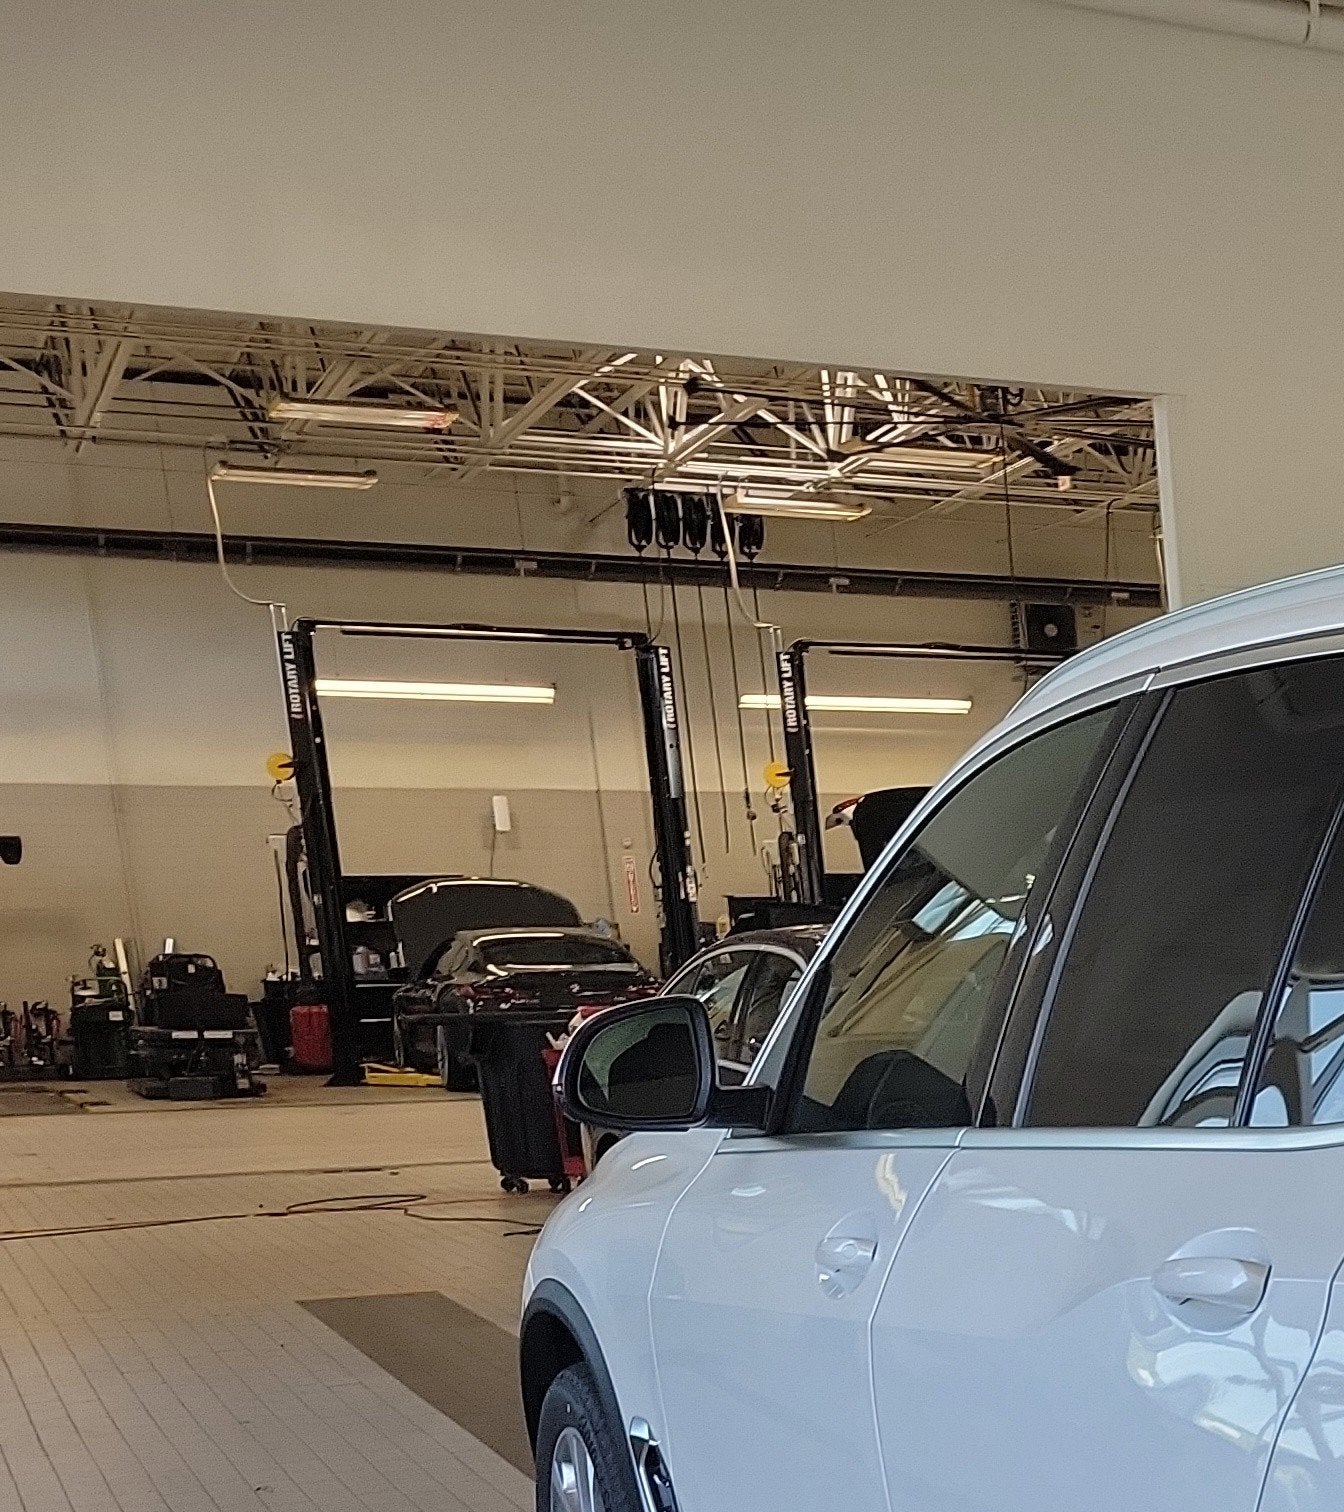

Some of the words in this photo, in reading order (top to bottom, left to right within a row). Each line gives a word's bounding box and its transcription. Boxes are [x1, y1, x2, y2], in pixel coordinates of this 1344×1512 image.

[281, 632, 295, 660] LIFT
[659, 647, 671, 673] LIFT
[780, 653, 792, 679] LIFT
[285, 662, 303, 712] ROTARY
[662, 675, 675, 722] ROTARY
[783, 680, 797, 727] ROTARY
